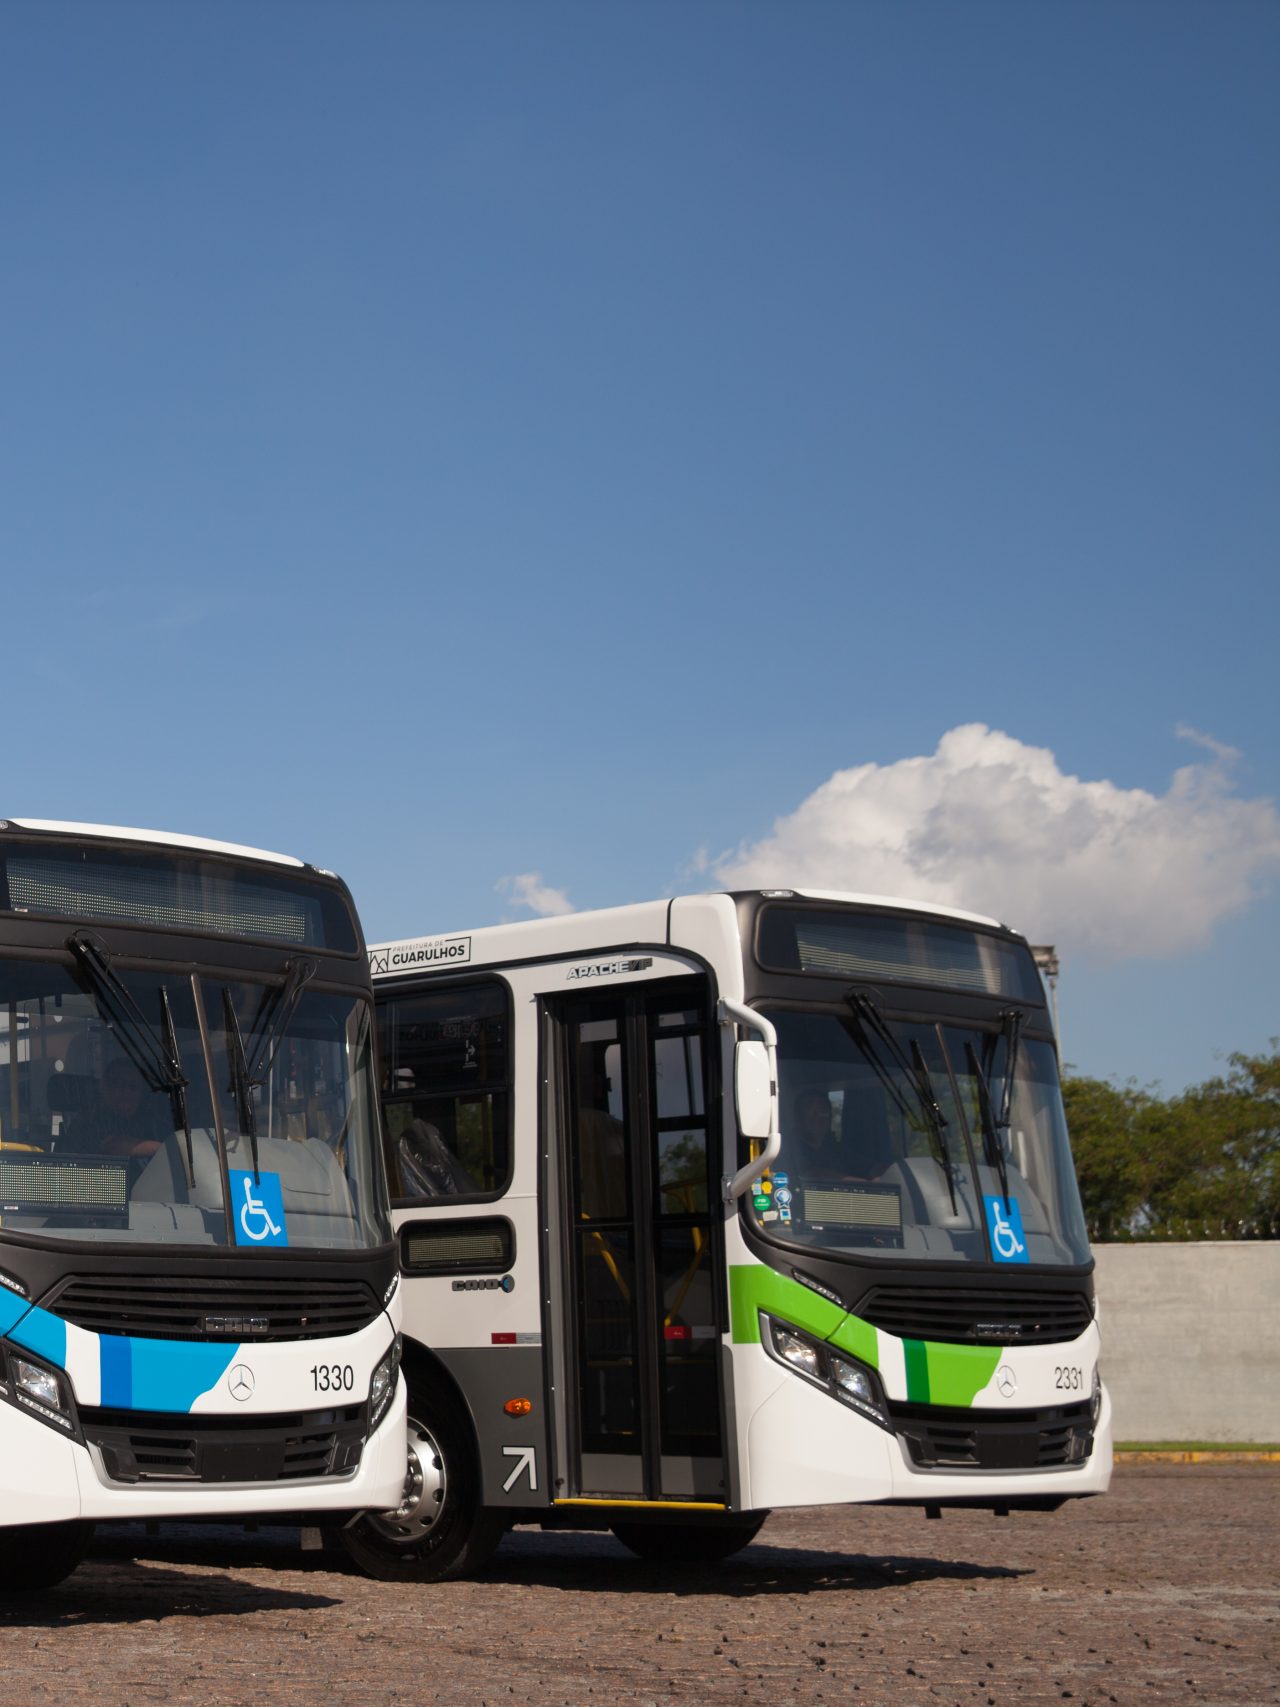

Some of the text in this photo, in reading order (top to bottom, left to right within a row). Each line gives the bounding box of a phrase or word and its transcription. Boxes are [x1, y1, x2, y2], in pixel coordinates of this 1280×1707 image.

[392, 945, 465, 965] GUARULHOS
[567, 961, 629, 980] APACHE
[310, 1364, 354, 1391] 1330
[1055, 1366, 1083, 1390] 2331
